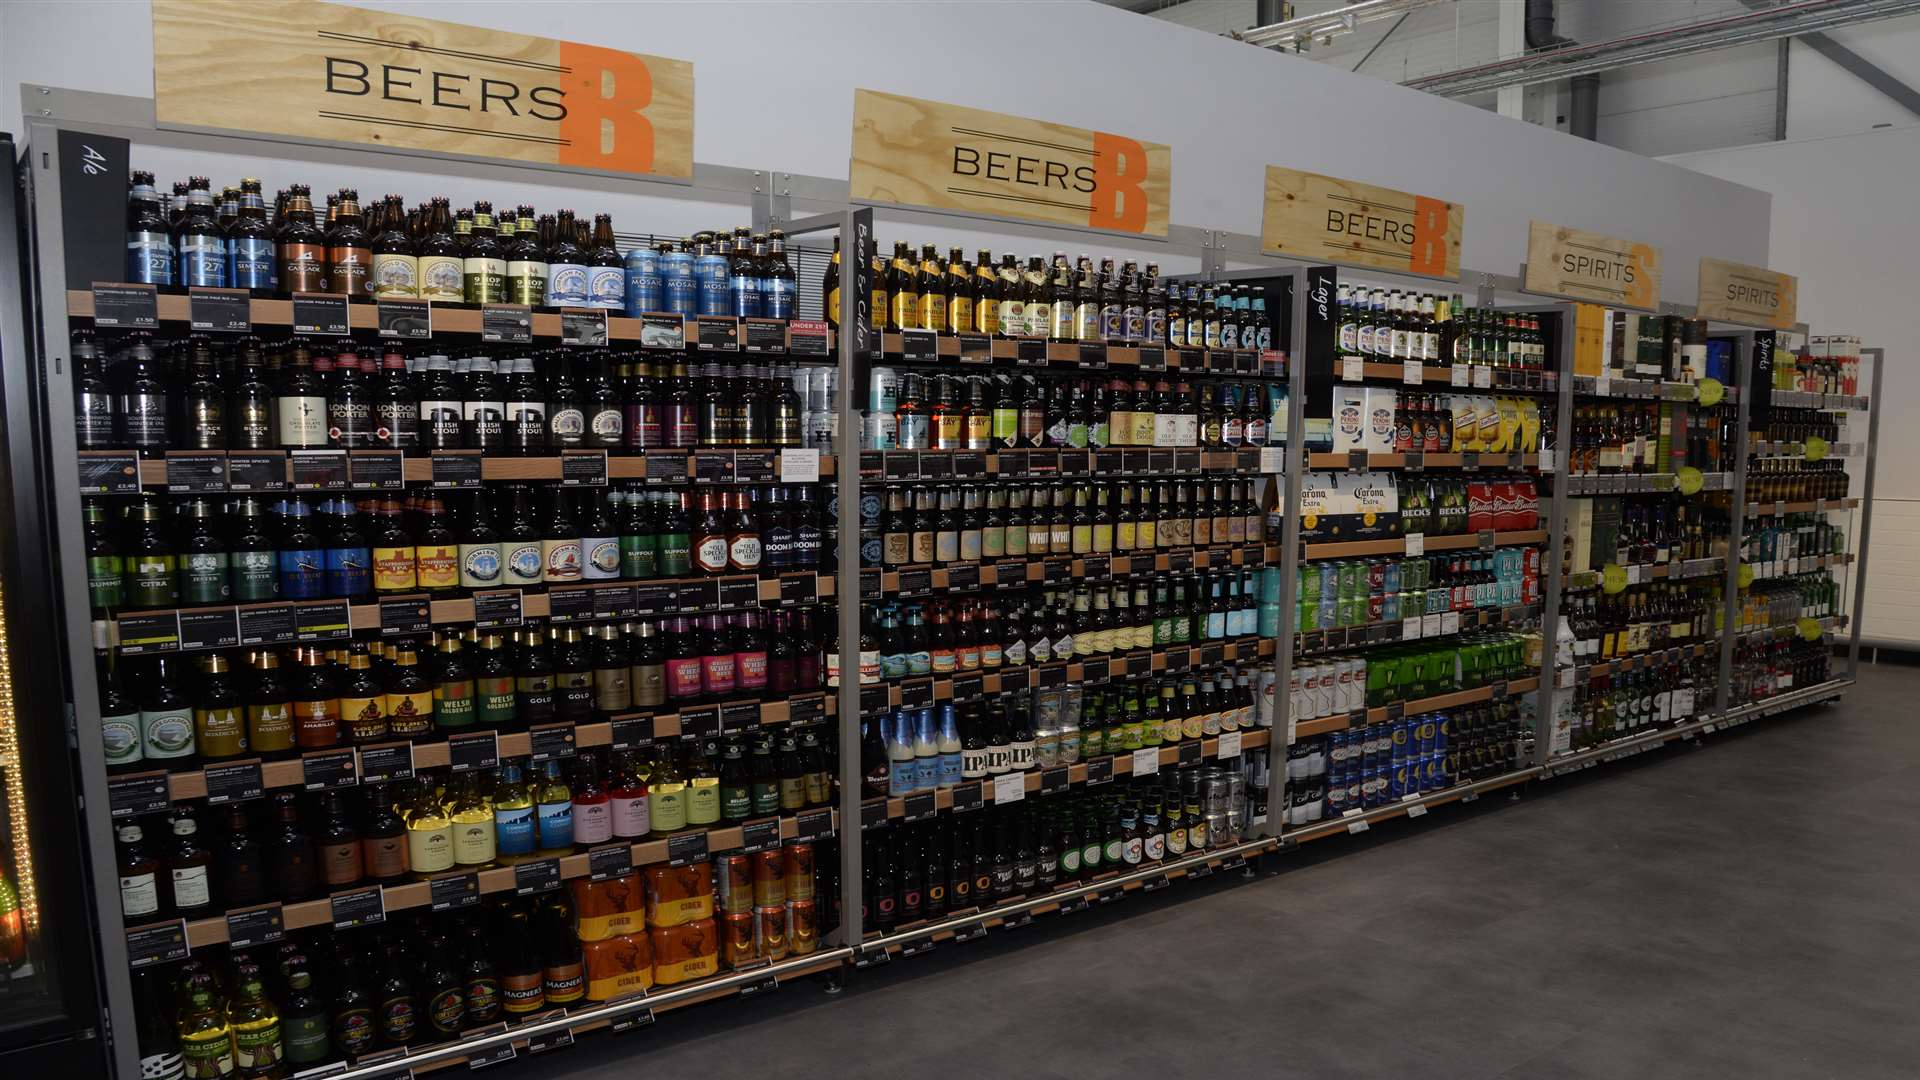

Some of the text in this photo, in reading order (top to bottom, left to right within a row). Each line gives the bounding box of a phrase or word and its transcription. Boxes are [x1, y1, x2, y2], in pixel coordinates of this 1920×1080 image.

[323, 56, 568, 122] BEERS
[559, 41, 655, 174] B
[81, 144, 108, 176] Ale
[953, 147, 1098, 193] BEERS
[1089, 131, 1149, 235] B
[1327, 209, 1417, 245] BEERS
[1409, 195, 1449, 276] B
[857, 222, 867, 267] Beer
[1562, 253, 1636, 284] SPIRITS
[1627, 243, 1655, 307] S
[1310, 275, 1333, 321] Lager
[1726, 283, 1779, 308] SPIRITS
[856, 299, 867, 350] Cider
[328, 403, 371, 412] LONDON
[333, 411, 369, 419] PORTER
[376, 404, 418, 413] LONDON
[381, 411, 417, 420] PORTER
[1301, 486, 1326, 498] orona
[1353, 485, 1384, 499] Corona
[444, 699, 471, 708] WELSH
[489, 695, 514, 704] WELSH
[529, 696, 552, 704] GOLD
[567, 692, 590, 700] GOLD
[608, 917, 631, 928] CIDER
[683, 961, 707, 972] CIDER
[617, 975, 641, 987] CIDER
